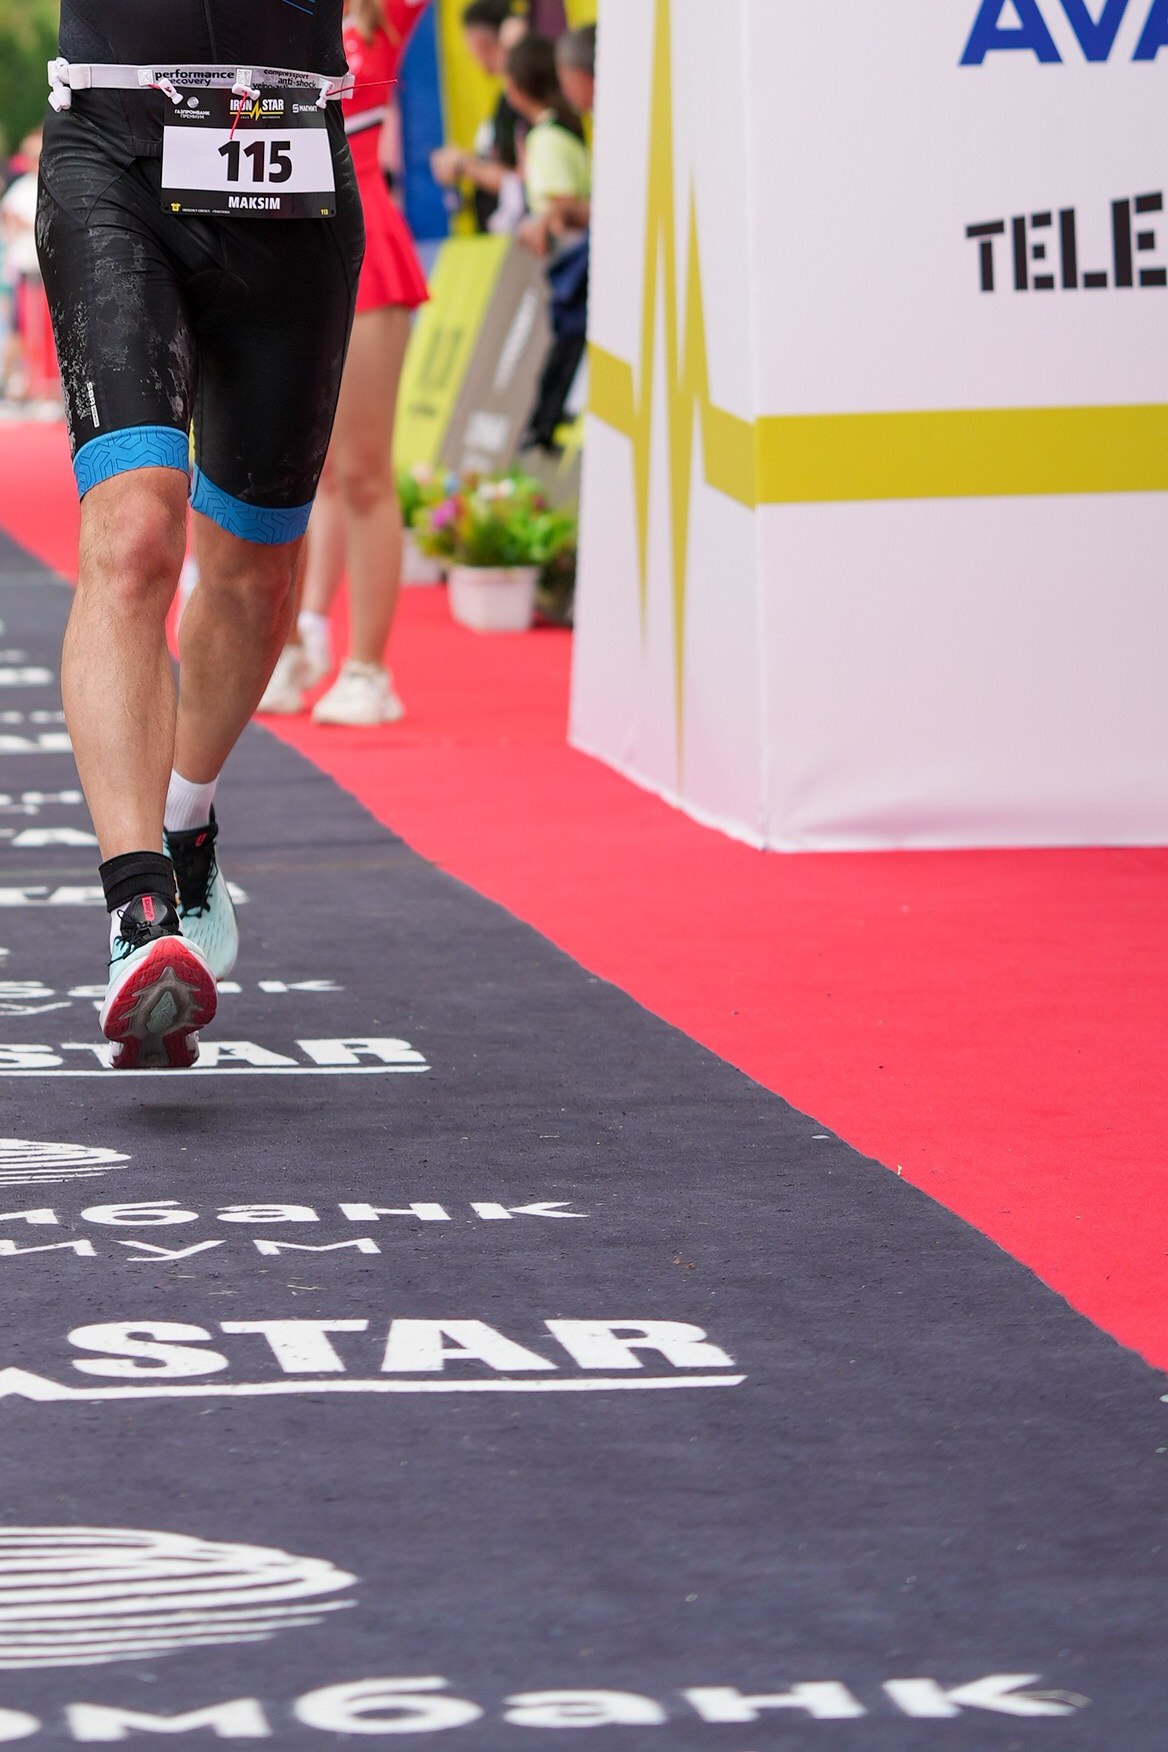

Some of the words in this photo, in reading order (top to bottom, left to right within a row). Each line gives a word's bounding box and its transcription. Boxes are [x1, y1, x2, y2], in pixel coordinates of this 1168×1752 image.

[154, 68, 235, 82] performance
[263, 69, 309, 80] compressport
[168, 78, 212, 87] ecovery
[277, 77, 317, 89] anti-shock
[229, 99, 253, 111] IRON
[262, 99, 285, 111] STAR
[218, 140, 292, 183] 115
[228, 195, 281, 210] MAKSIM
[965, 191, 1168, 293] TELE
[67, 1318, 736, 1378] STAR
